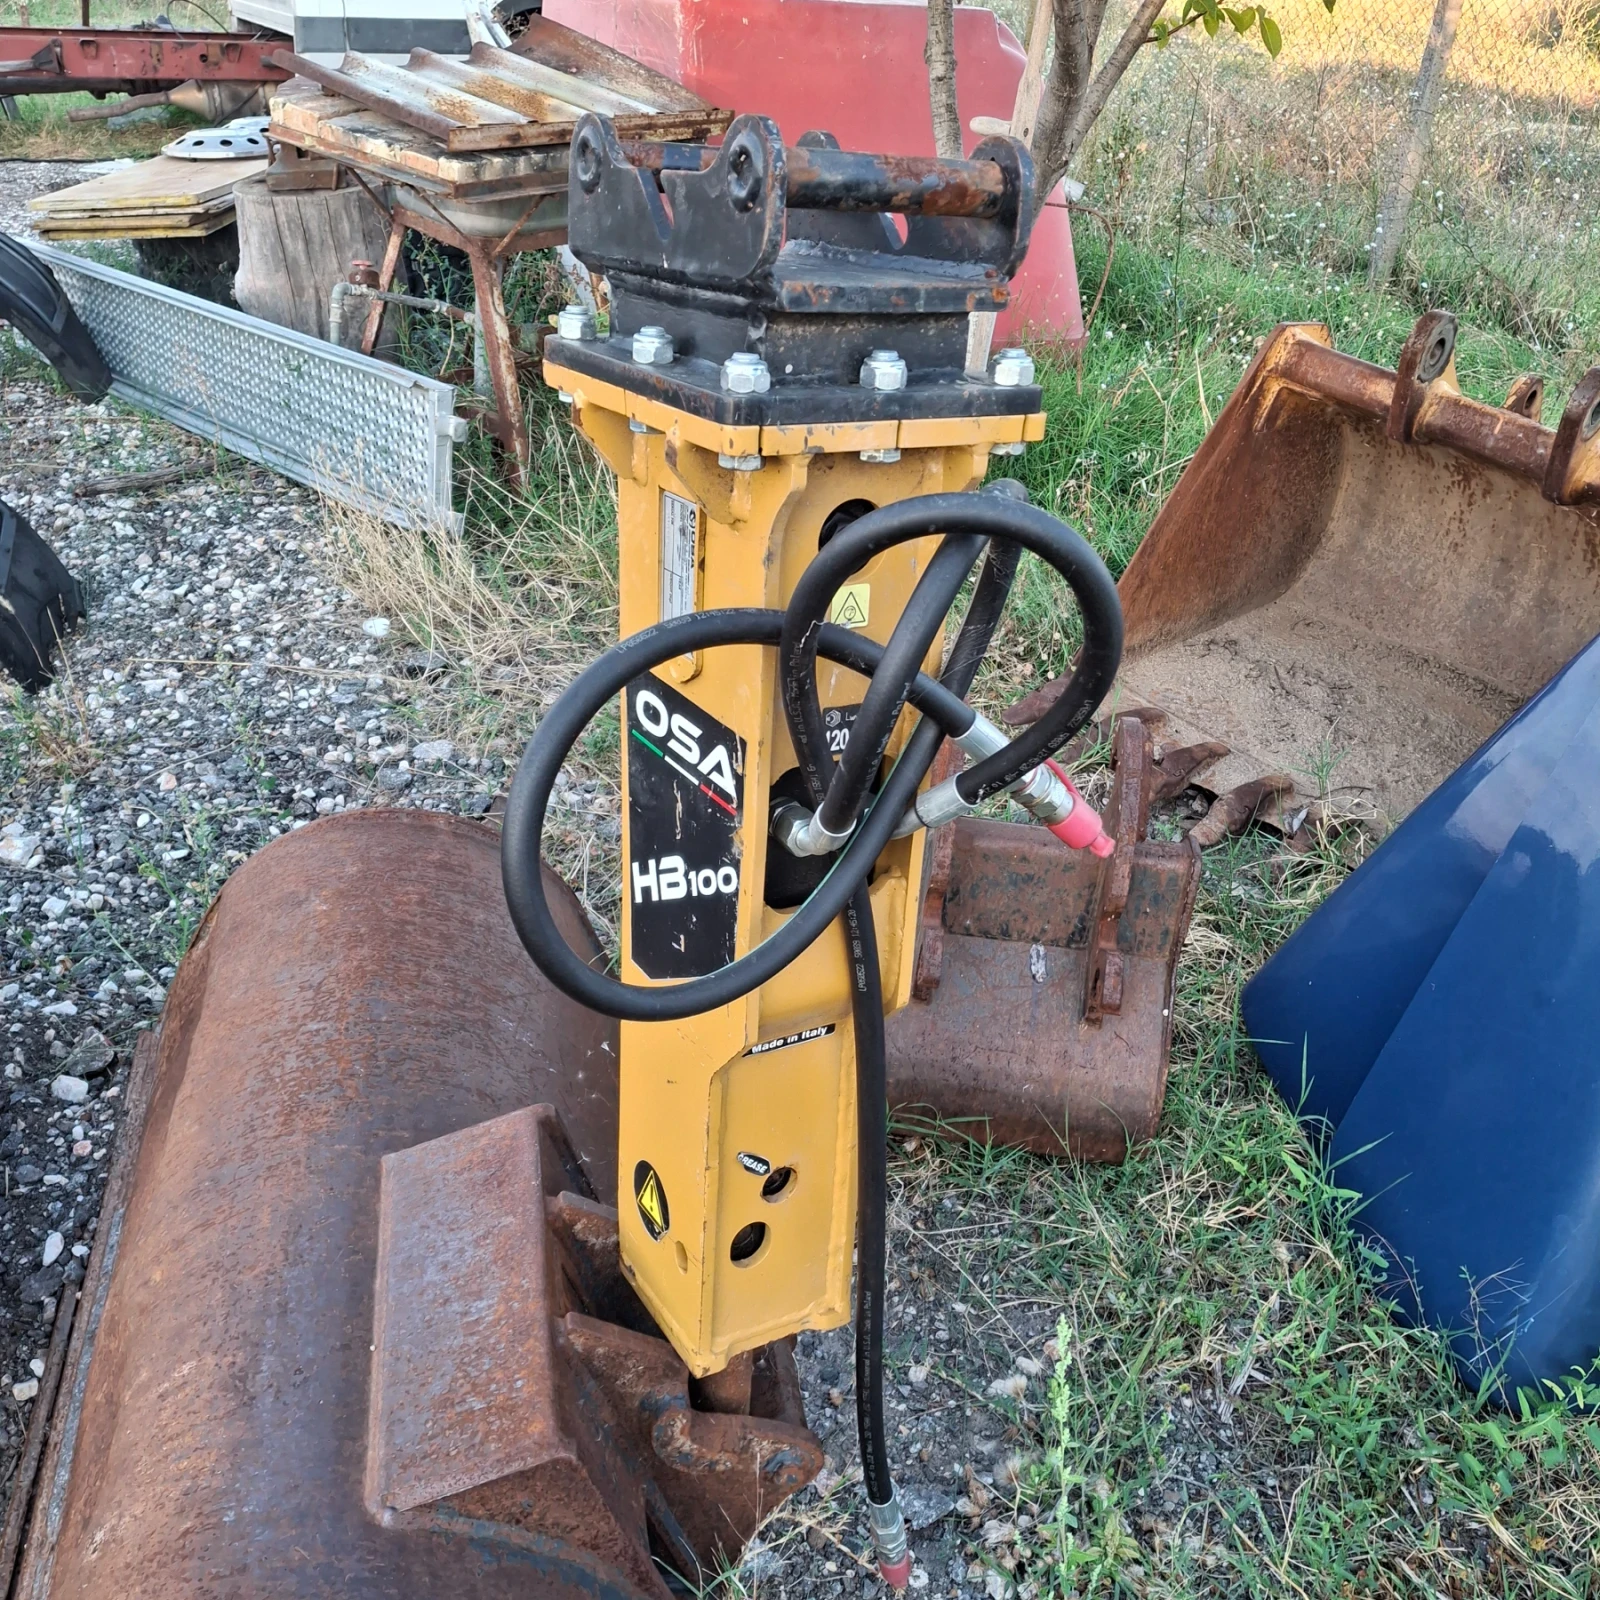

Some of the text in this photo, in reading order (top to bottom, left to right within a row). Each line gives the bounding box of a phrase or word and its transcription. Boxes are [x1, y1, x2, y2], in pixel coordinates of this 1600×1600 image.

[635, 689, 737, 807] OSA
[631, 855, 738, 904] HB100
[751, 1026, 828, 1054] Made in Italy
[737, 1153, 768, 1174] GREASE
